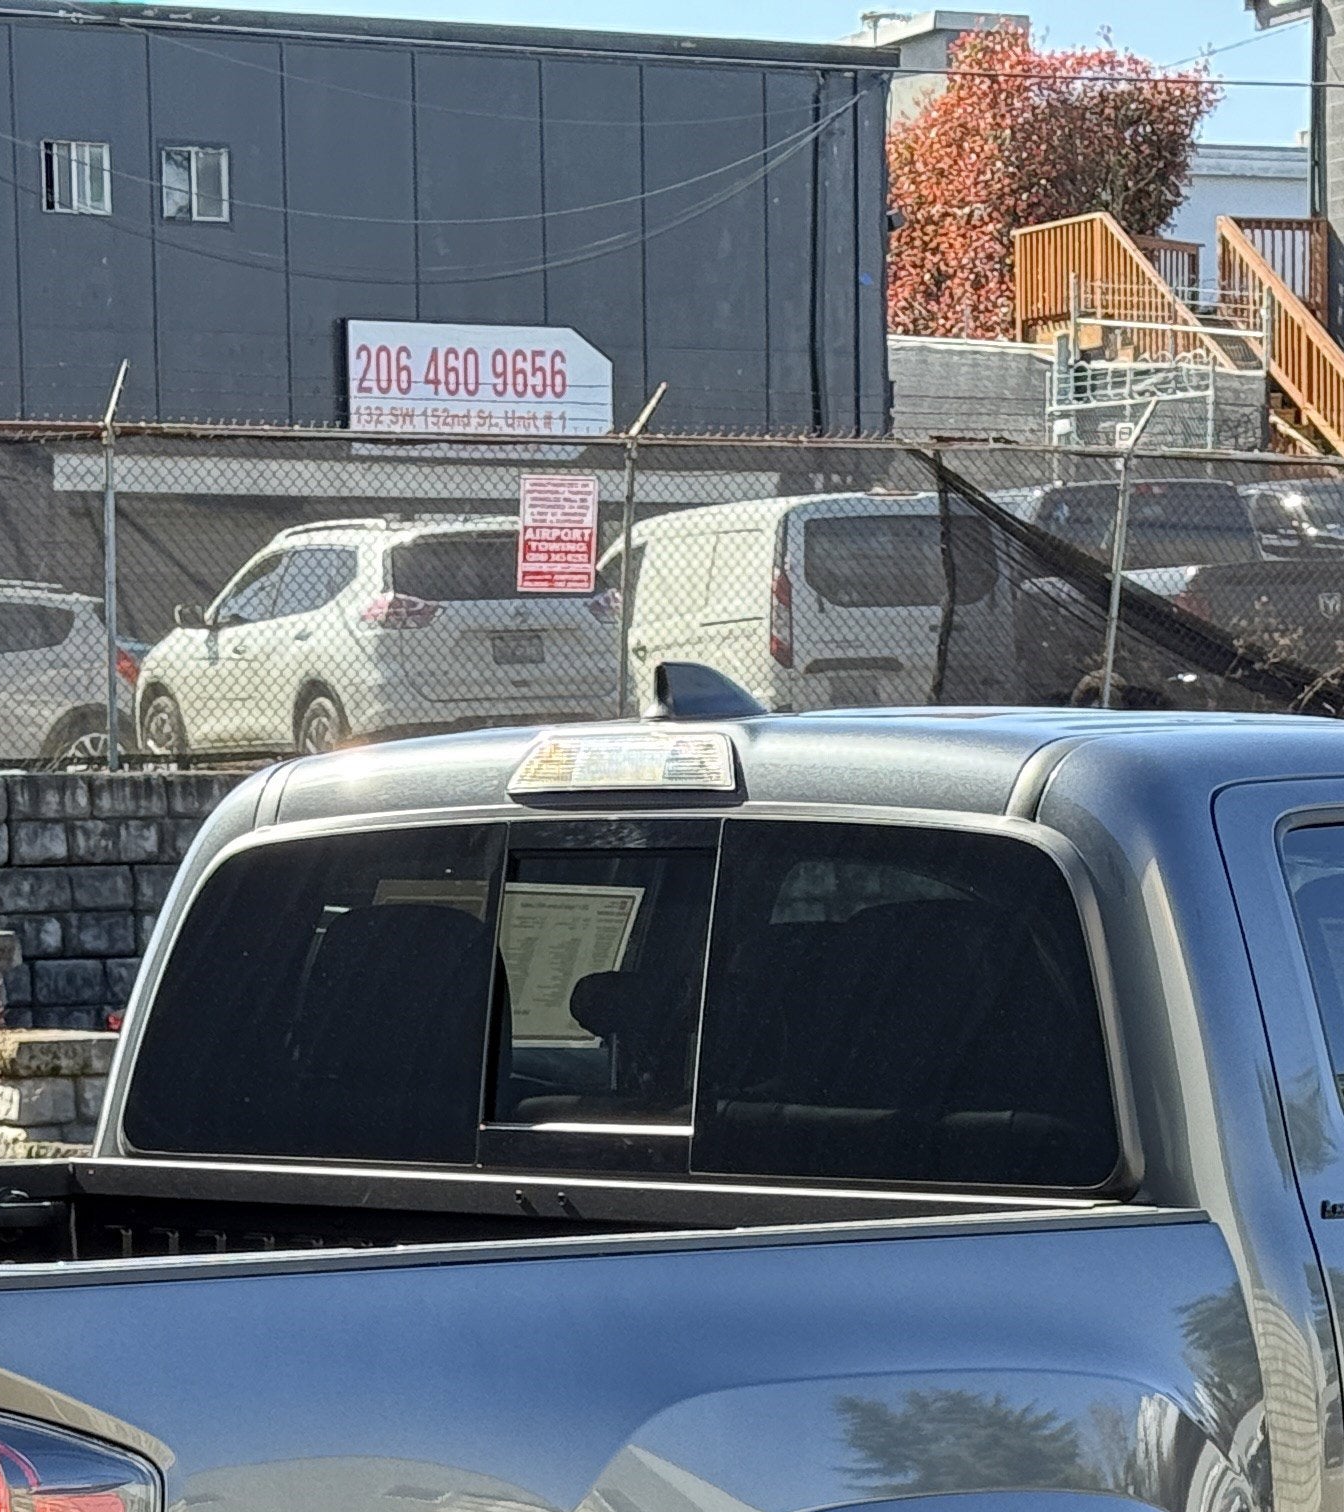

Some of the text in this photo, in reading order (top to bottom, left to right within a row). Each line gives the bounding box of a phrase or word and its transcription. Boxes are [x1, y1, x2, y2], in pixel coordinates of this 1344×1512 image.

[356, 344, 568, 399] 206 460 9656
[355, 405, 384, 426] 132
[389, 406, 416, 427] SW
[420, 407, 471, 429] 152nd
[525, 528, 592, 541] AIRPORT
